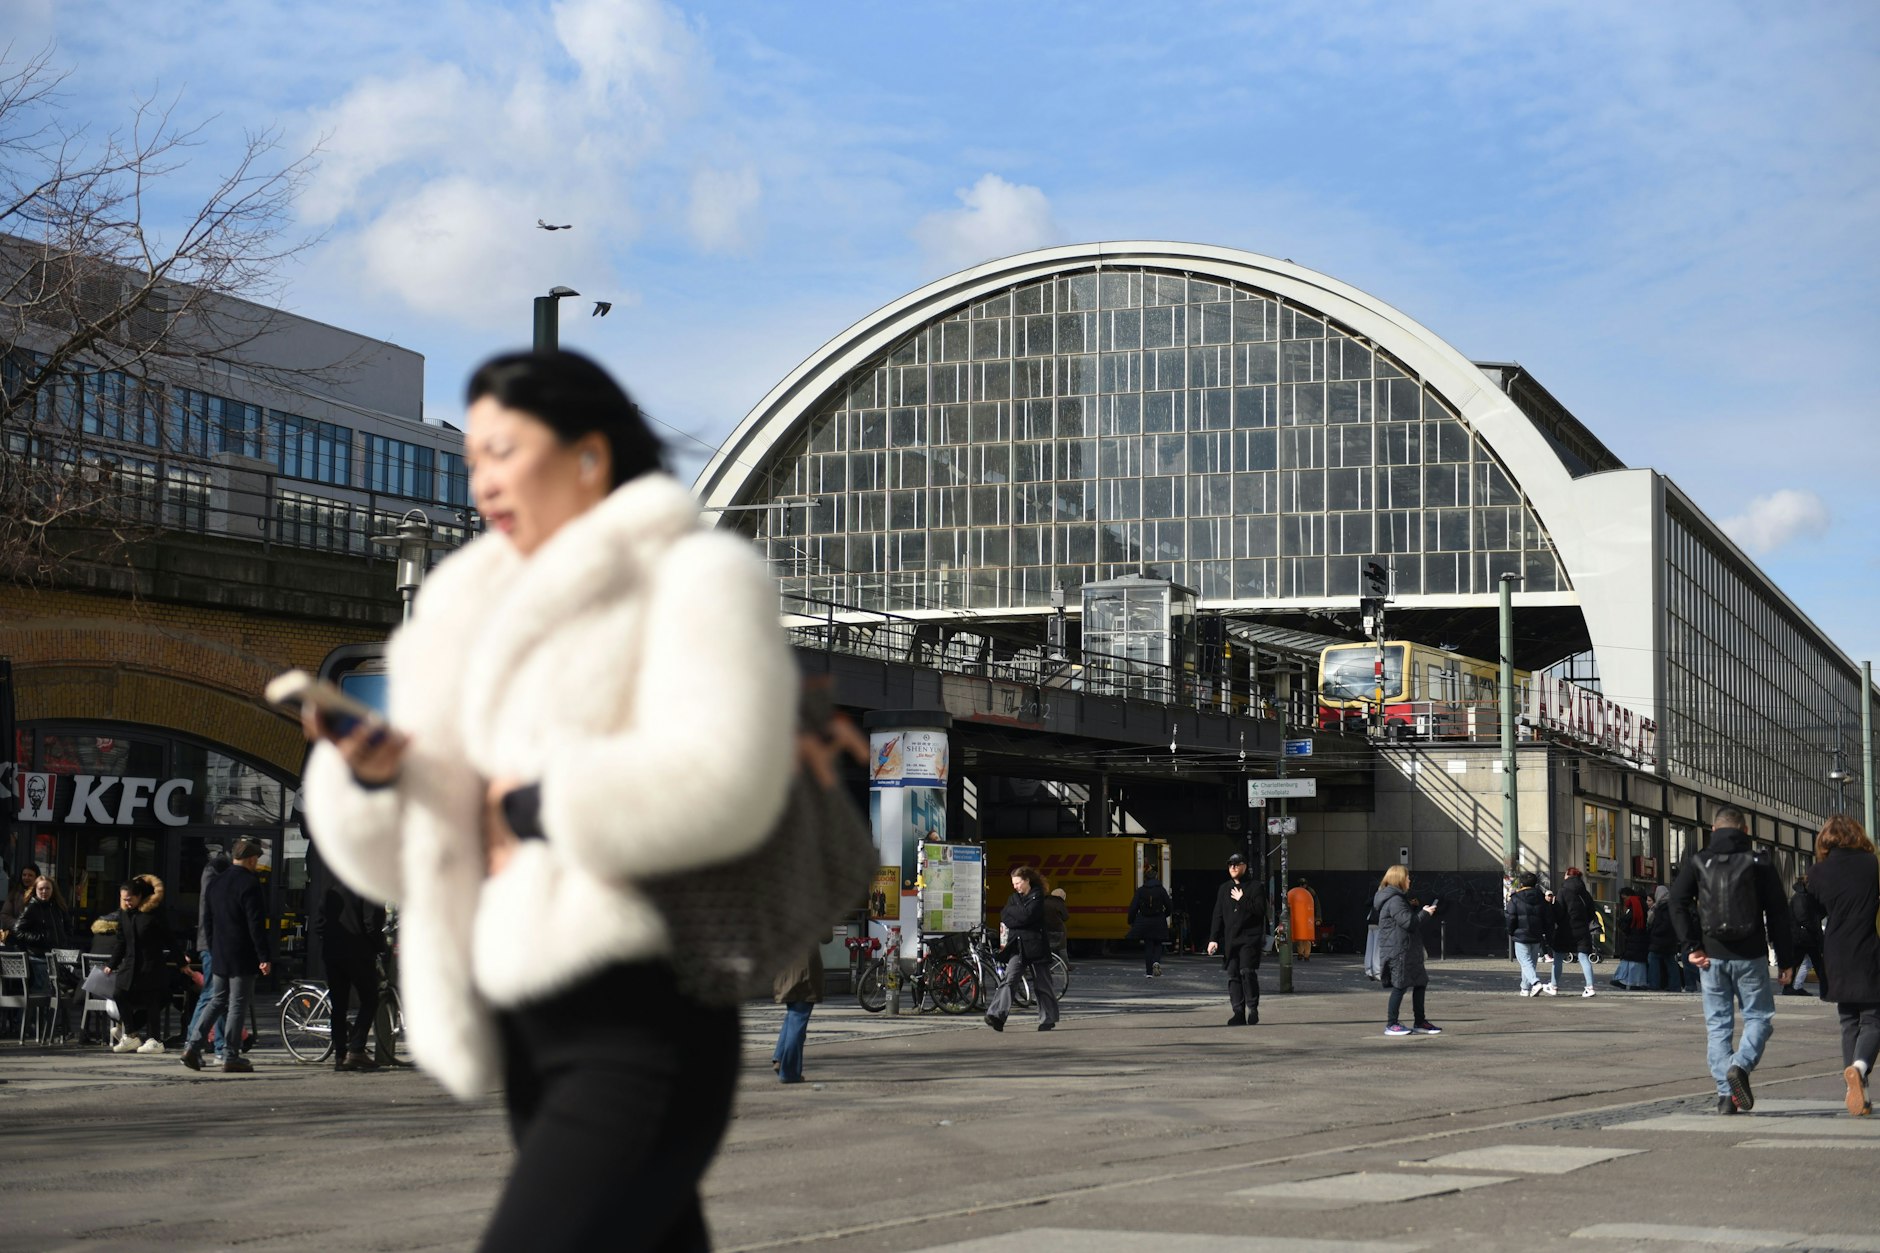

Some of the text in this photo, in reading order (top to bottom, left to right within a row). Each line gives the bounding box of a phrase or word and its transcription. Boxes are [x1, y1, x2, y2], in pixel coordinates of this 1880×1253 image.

[1539, 672, 1658, 765] ALEXANDERPLATZ
[64, 774, 194, 827] KFC
[1006, 854, 1102, 876] DHL
